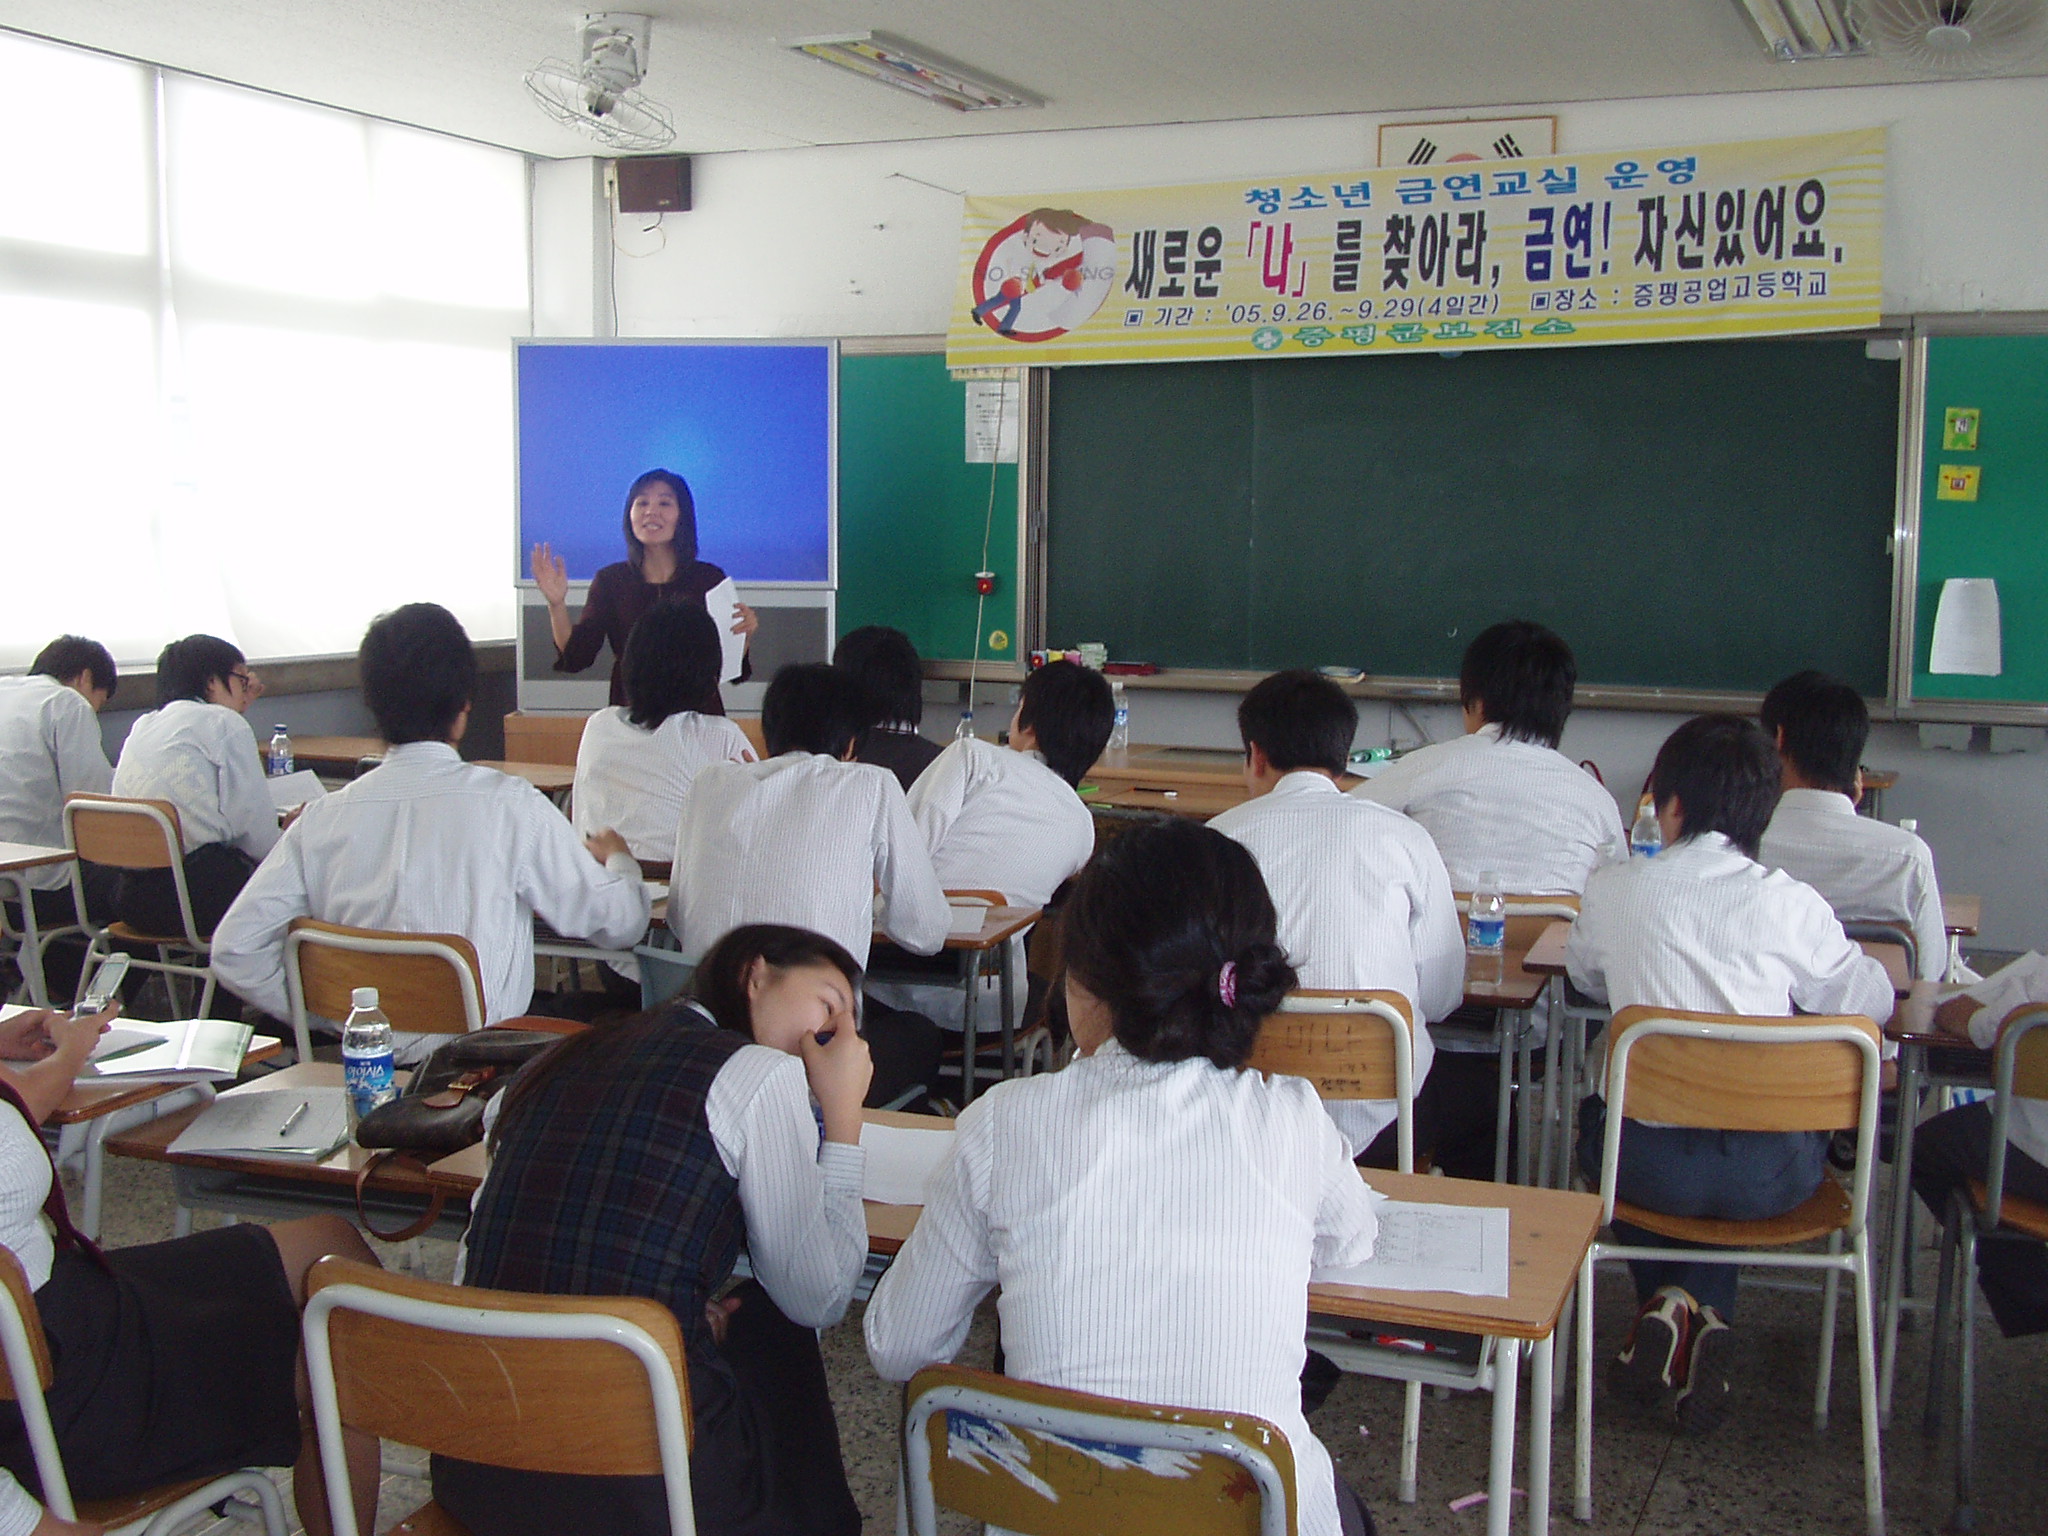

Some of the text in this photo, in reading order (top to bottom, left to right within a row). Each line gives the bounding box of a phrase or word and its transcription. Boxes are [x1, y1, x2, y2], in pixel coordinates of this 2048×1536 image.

[1244, 157, 1697, 215] 청소년 금연교실 운영
[1124, 226, 1222, 299] 새로운
[1382, 210, 1500, 291] 찾아라,
[1524, 201, 1611, 282] 금연!
[1634, 178, 1843, 273] 자신있어요.
[1154, 307, 1194, 327] 기간
[1554, 287, 1597, 312] 장소
[1633, 271, 1828, 308] 증평공업고등학교
[1291, 317, 1576, 348] 증평군보건소
